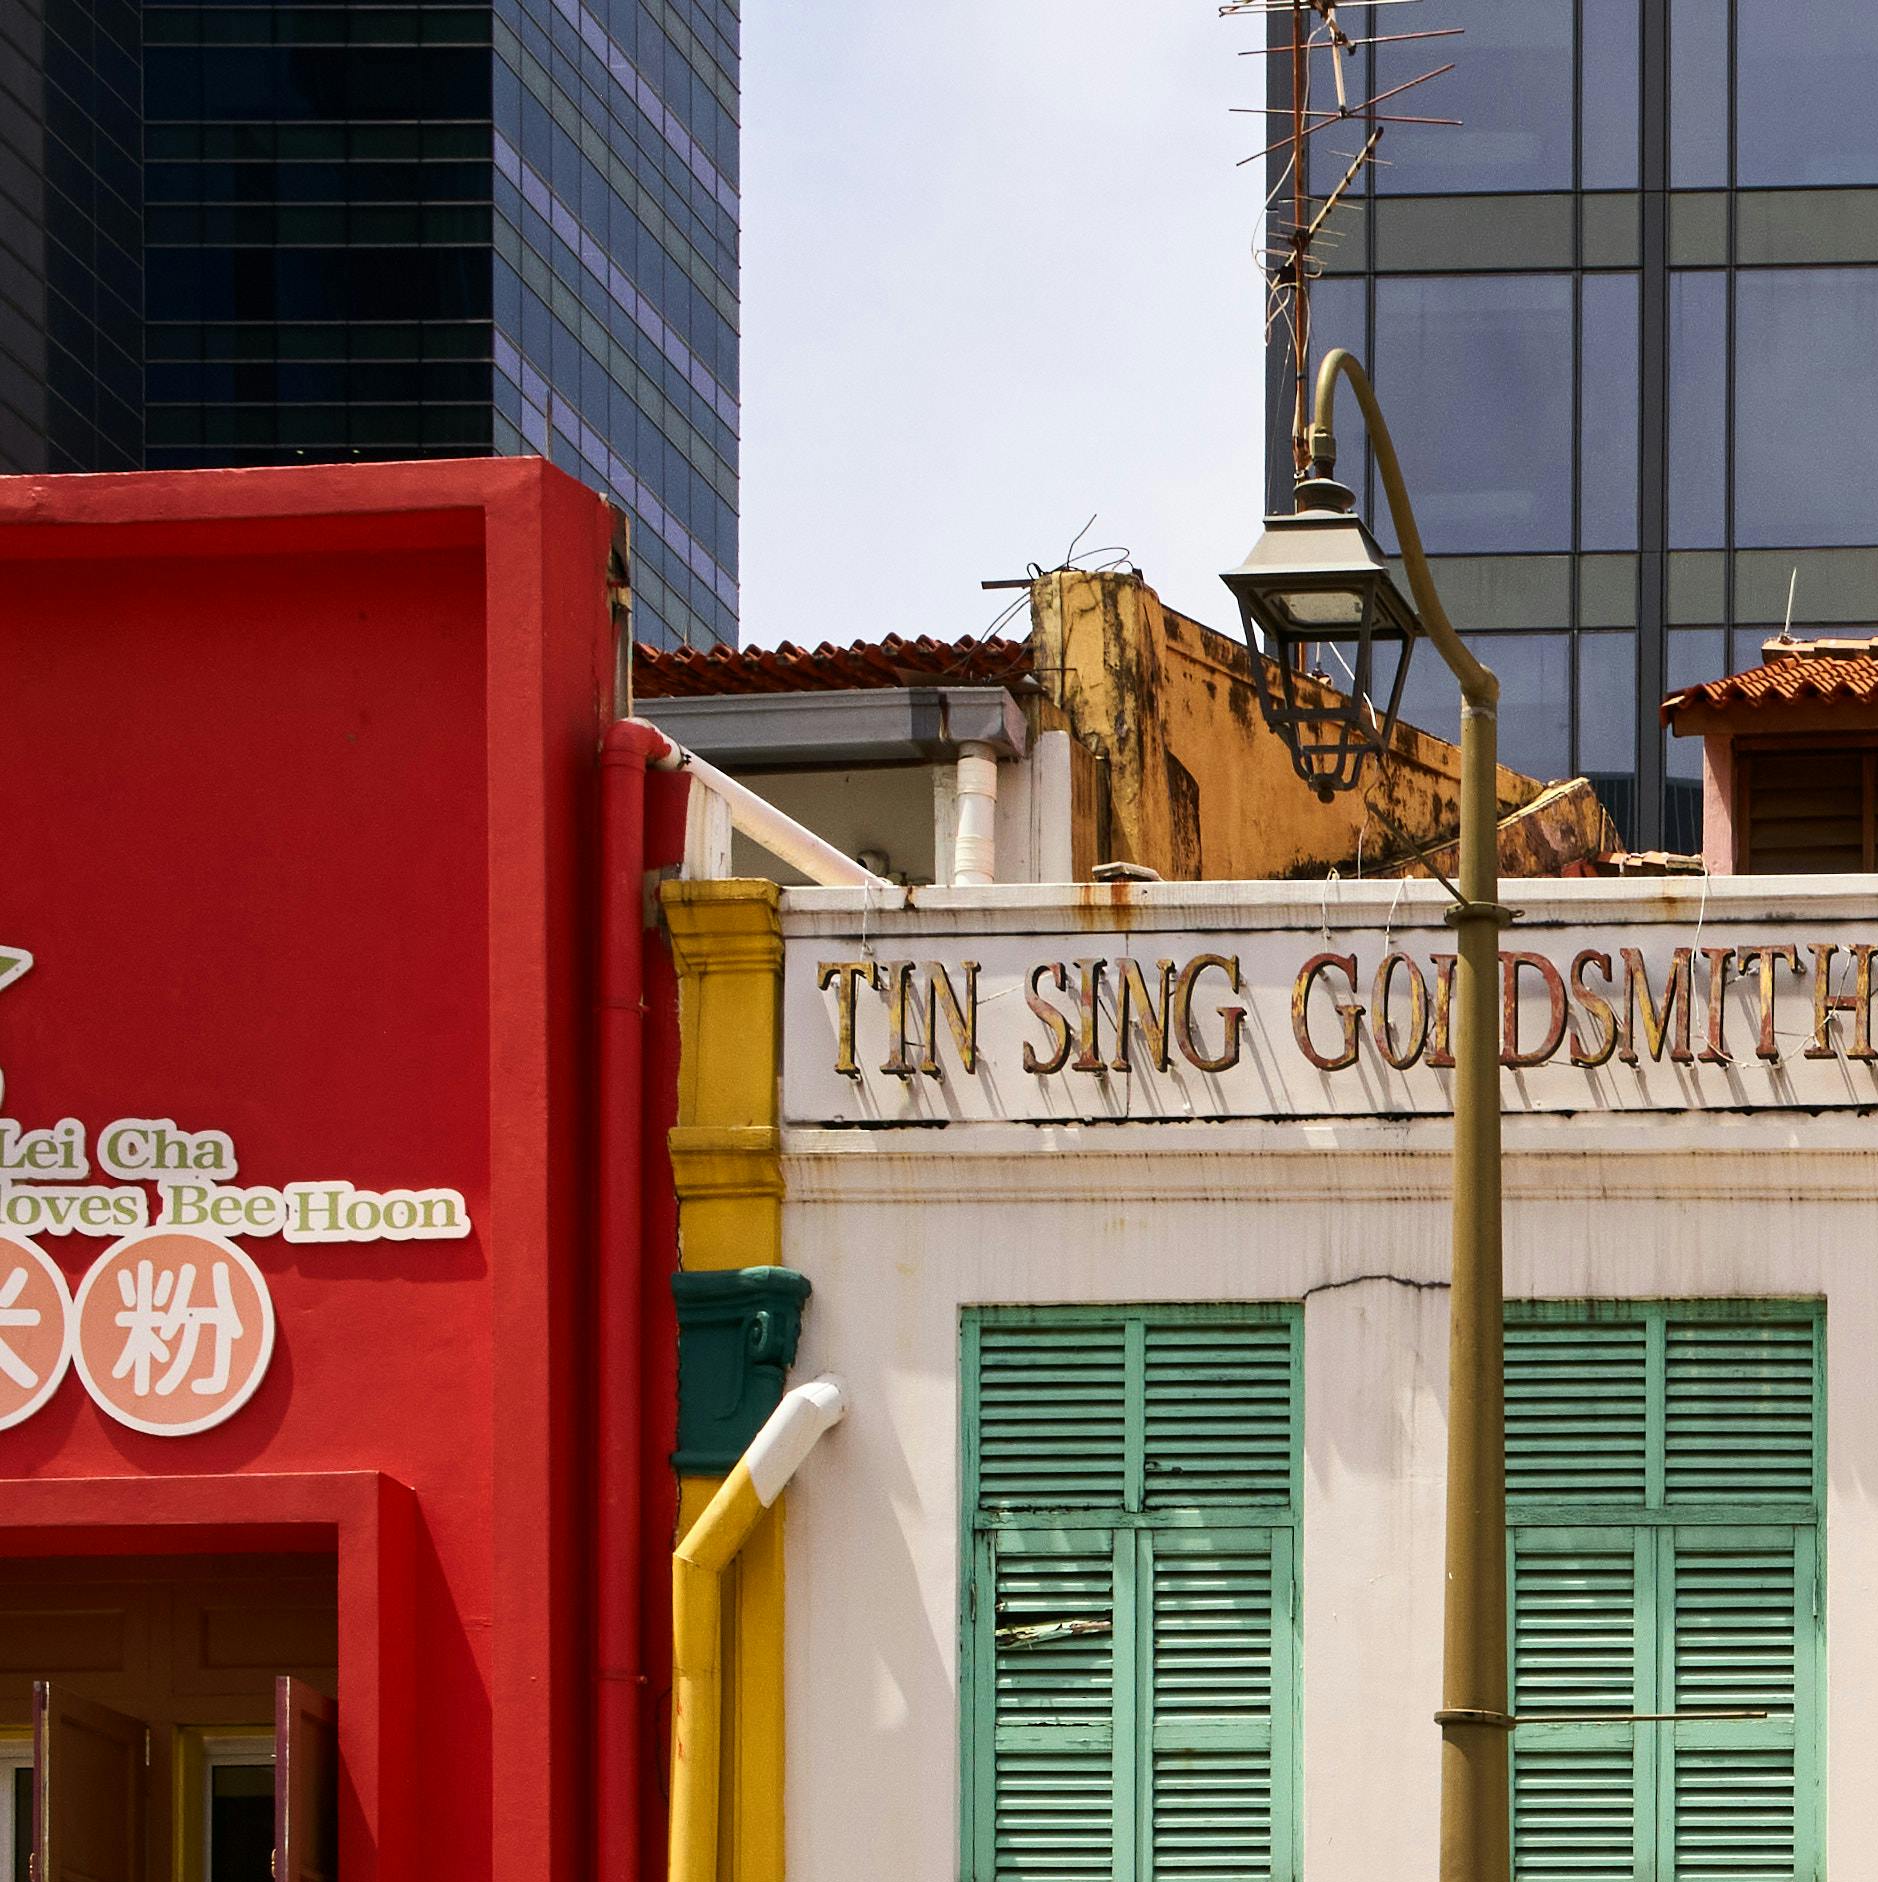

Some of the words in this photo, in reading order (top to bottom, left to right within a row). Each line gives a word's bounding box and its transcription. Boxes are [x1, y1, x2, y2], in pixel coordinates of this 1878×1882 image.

[816, 959, 980, 1080] TIN
[1022, 953, 1246, 1074] SING
[108, 1128, 227, 1170] Cha
[0, 1184, 138, 1227] oves
[167, 1185, 277, 1227] Bee
[295, 1190, 462, 1232] Hoon
